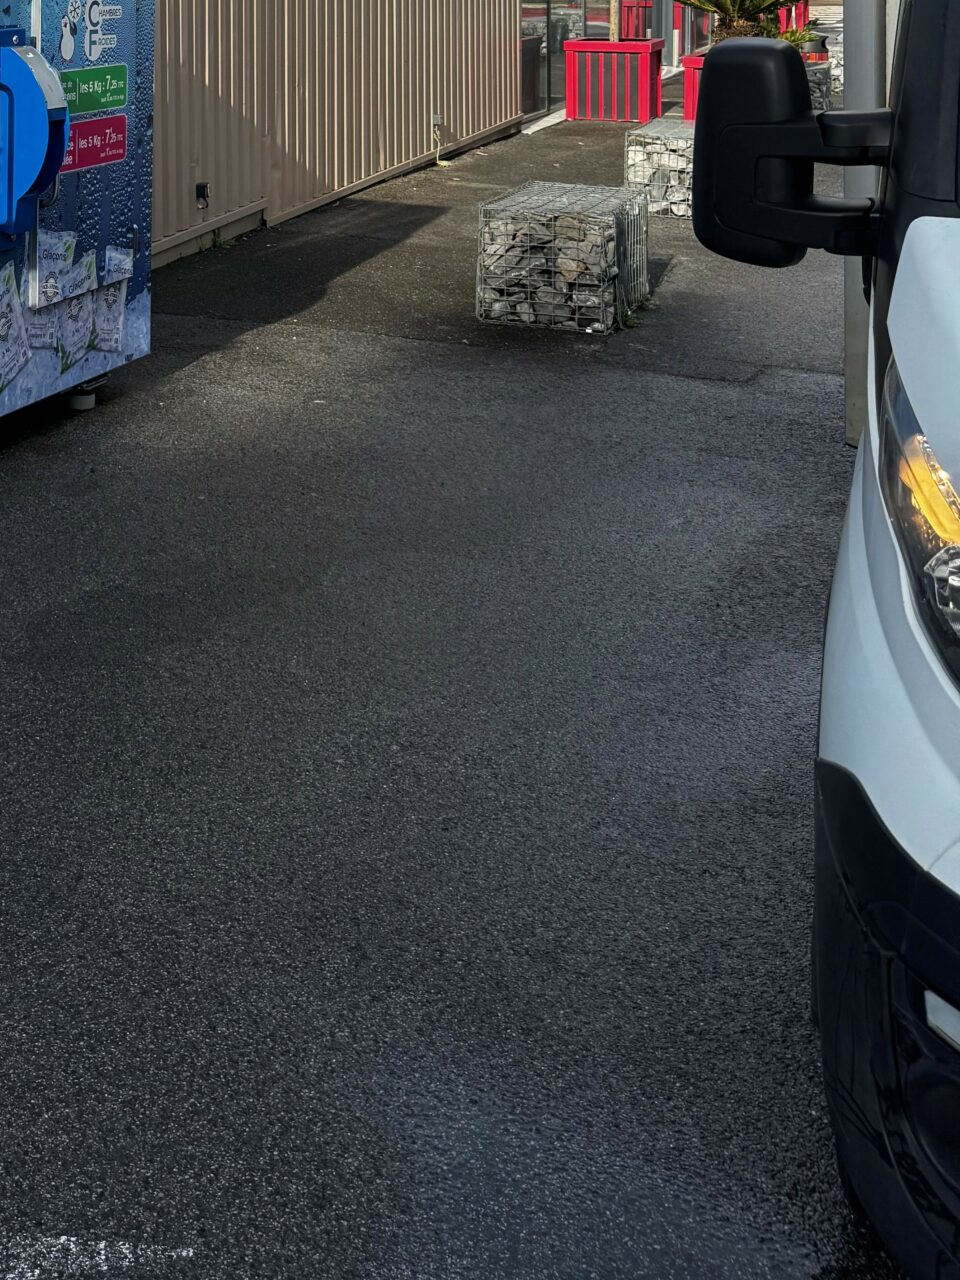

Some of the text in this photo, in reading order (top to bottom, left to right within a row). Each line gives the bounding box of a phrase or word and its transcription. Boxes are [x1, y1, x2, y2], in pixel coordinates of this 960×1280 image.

[80, 83, 88, 93] les
[89, 82, 93, 92] 5
[94, 80, 101, 93] Kg
[79, 135, 87, 149] les
[89, 136, 93, 147] 5
[94, 134, 101, 147] Kg
